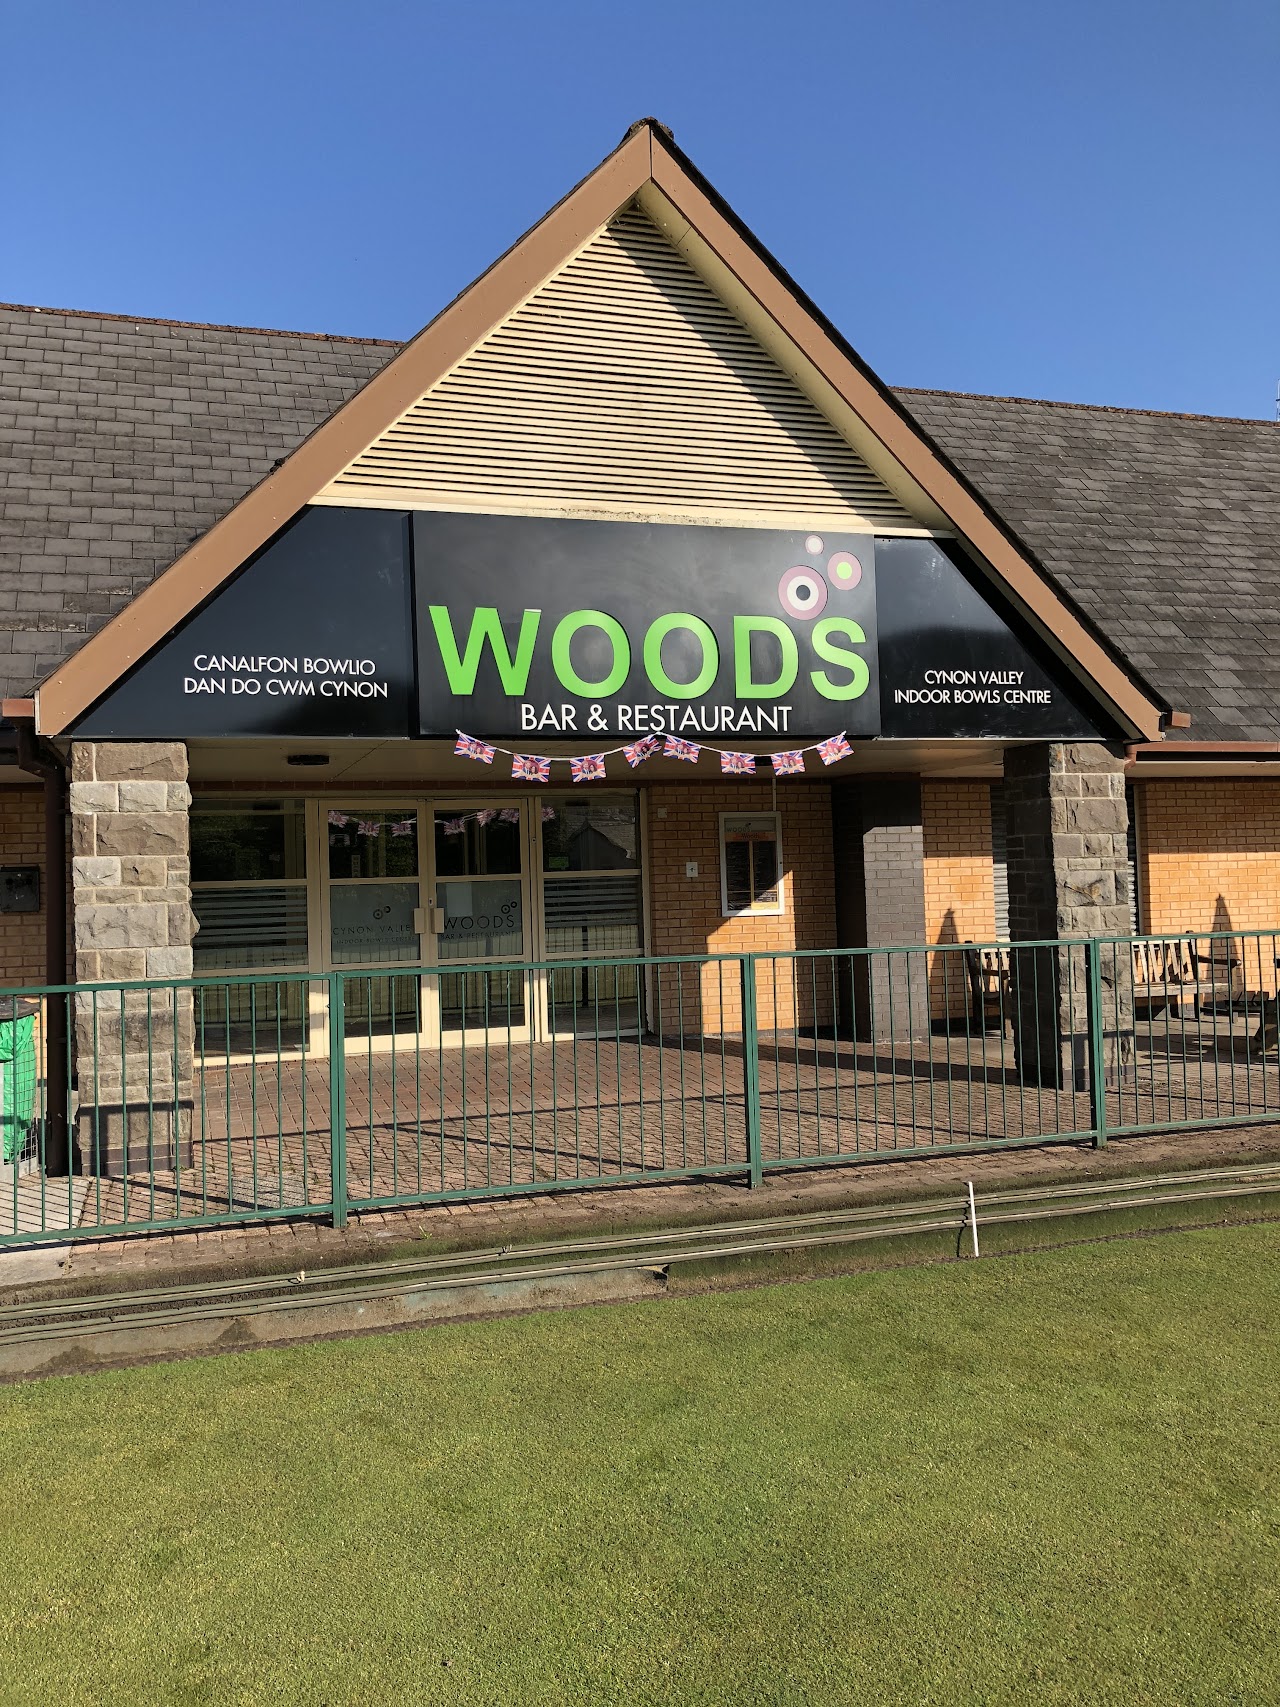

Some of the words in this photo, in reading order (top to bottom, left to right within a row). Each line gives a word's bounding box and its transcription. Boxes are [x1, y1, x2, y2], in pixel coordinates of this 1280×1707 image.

[429, 605, 870, 701] WOODS
[193, 654, 298, 674] CANALFON
[303, 658, 376, 676] BOWLIO
[924, 669, 977, 685] CYNON
[978, 671, 1024, 685] VALLEY
[183, 677, 226, 695] DAN
[231, 678, 261, 695] DO
[266, 679, 316, 696] CWM
[319, 680, 388, 698] CYNON
[894, 689, 951, 704] INDOOR
[954, 689, 1001, 704] BOWLS
[1003, 690, 1052, 704] CENTRE
[521, 703, 579, 731] BAR
[587, 704, 610, 731] &
[617, 704, 793, 732] RESTAURANT
[332, 926, 373, 936] CYNON
[379, 924, 413, 934] VALLE
[443, 914, 515, 930] WOODS
